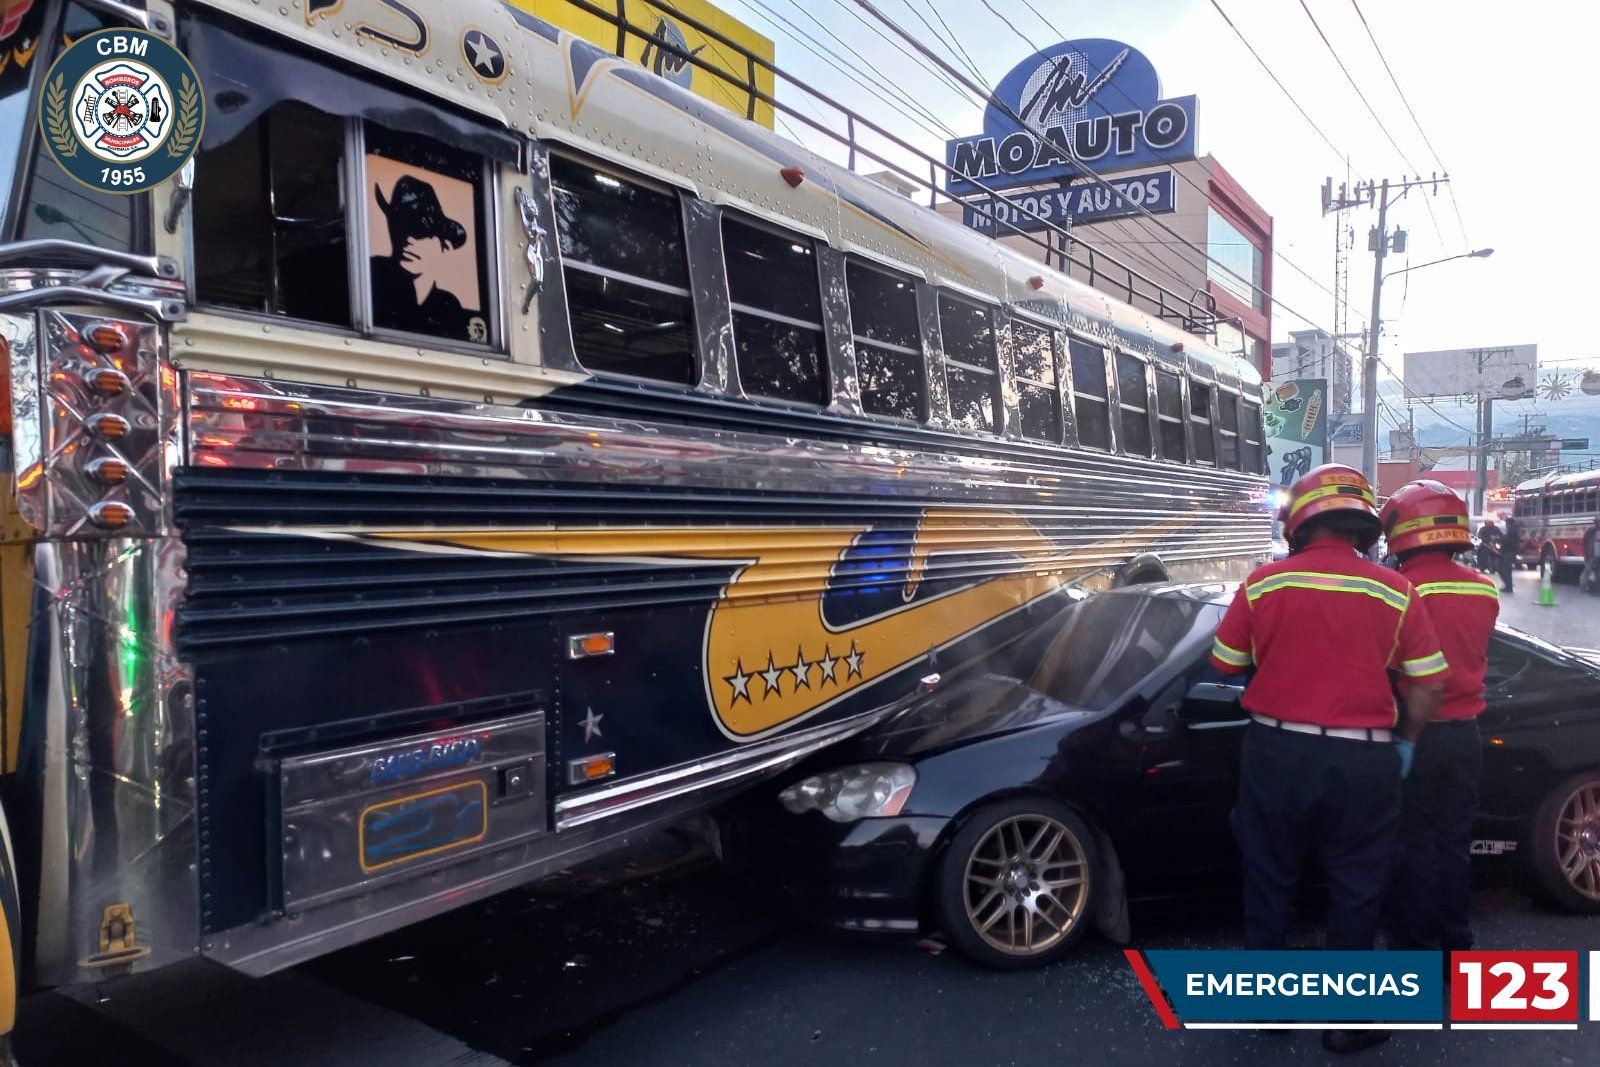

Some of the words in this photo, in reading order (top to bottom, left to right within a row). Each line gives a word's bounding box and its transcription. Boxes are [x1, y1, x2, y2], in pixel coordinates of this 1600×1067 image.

[951, 103, 1188, 183] MOAUTO
[972, 196, 1056, 229] MOTOS
[1056, 191, 1073, 216] Y
[1077, 177, 1161, 213] AUTOS
[429, 738, 481, 769] BIRD
